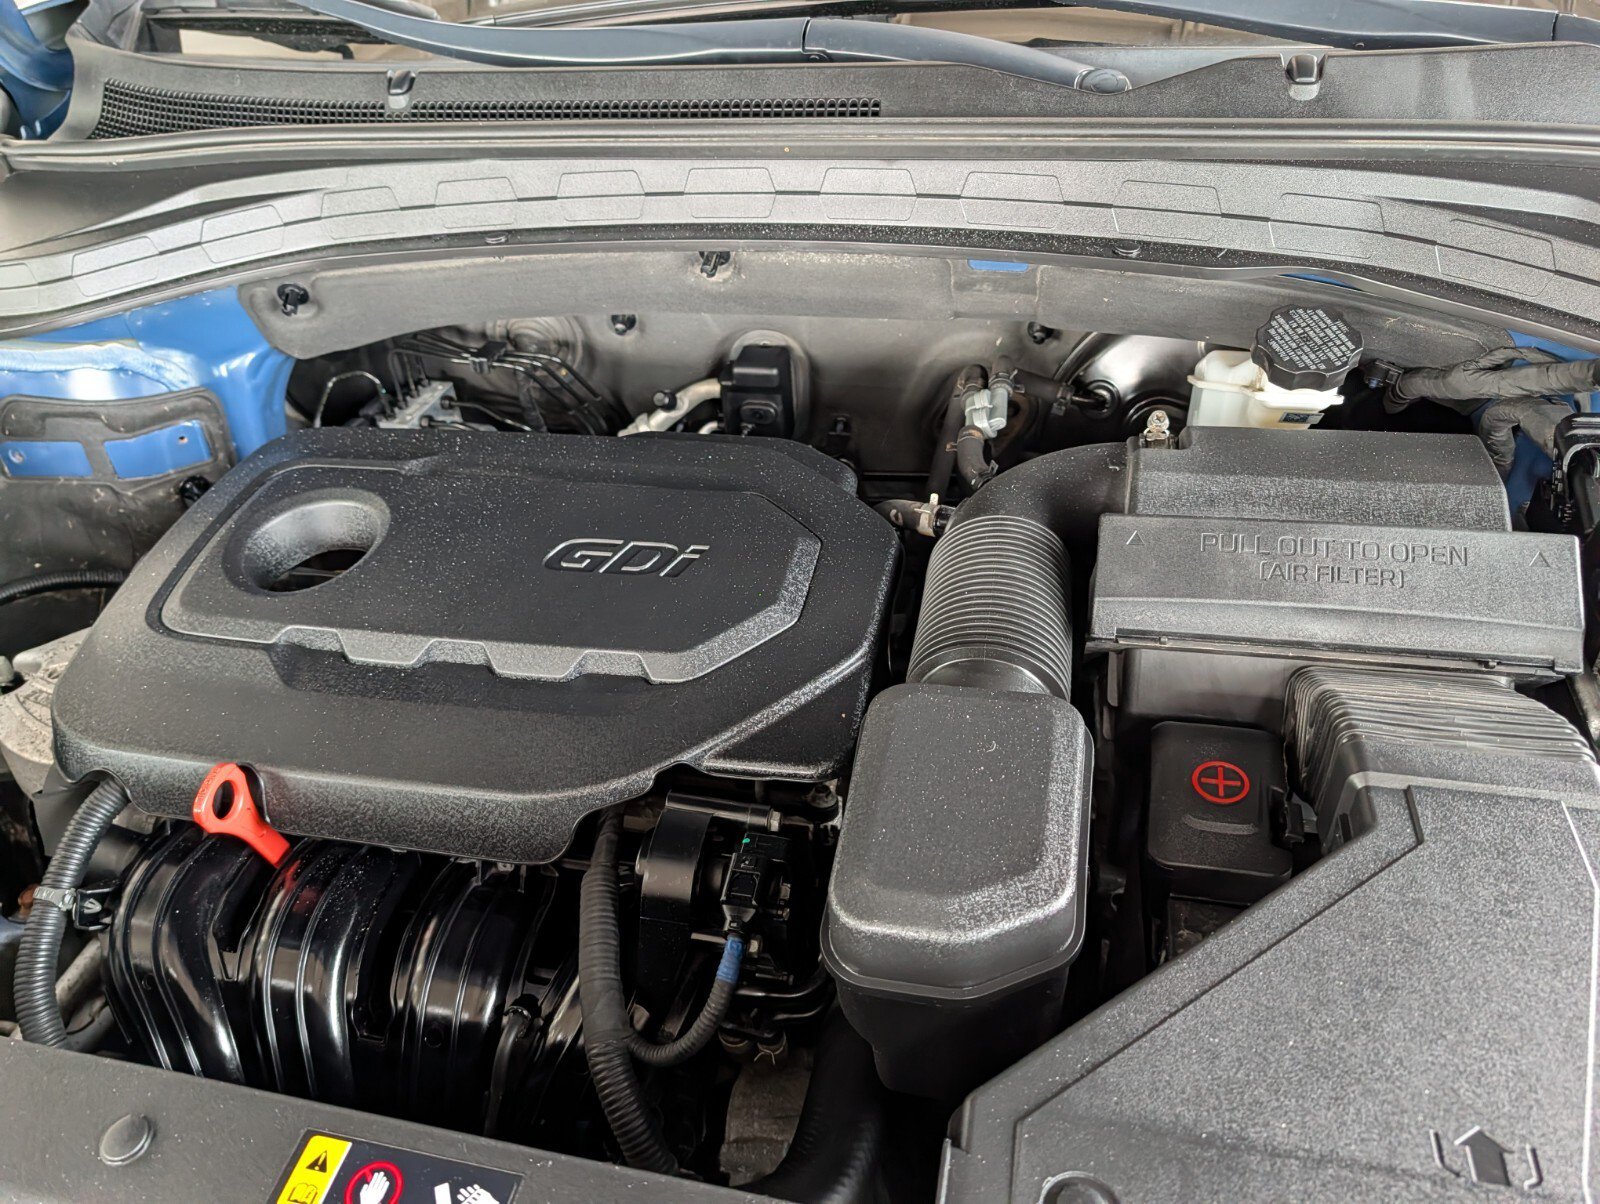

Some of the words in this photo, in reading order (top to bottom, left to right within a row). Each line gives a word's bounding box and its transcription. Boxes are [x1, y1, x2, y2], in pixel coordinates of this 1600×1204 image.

[1200, 532, 1271, 556] PULL
[1277, 535, 1336, 558] OUT
[1341, 538, 1380, 561] TO
[1388, 541, 1468, 567] OPEN
